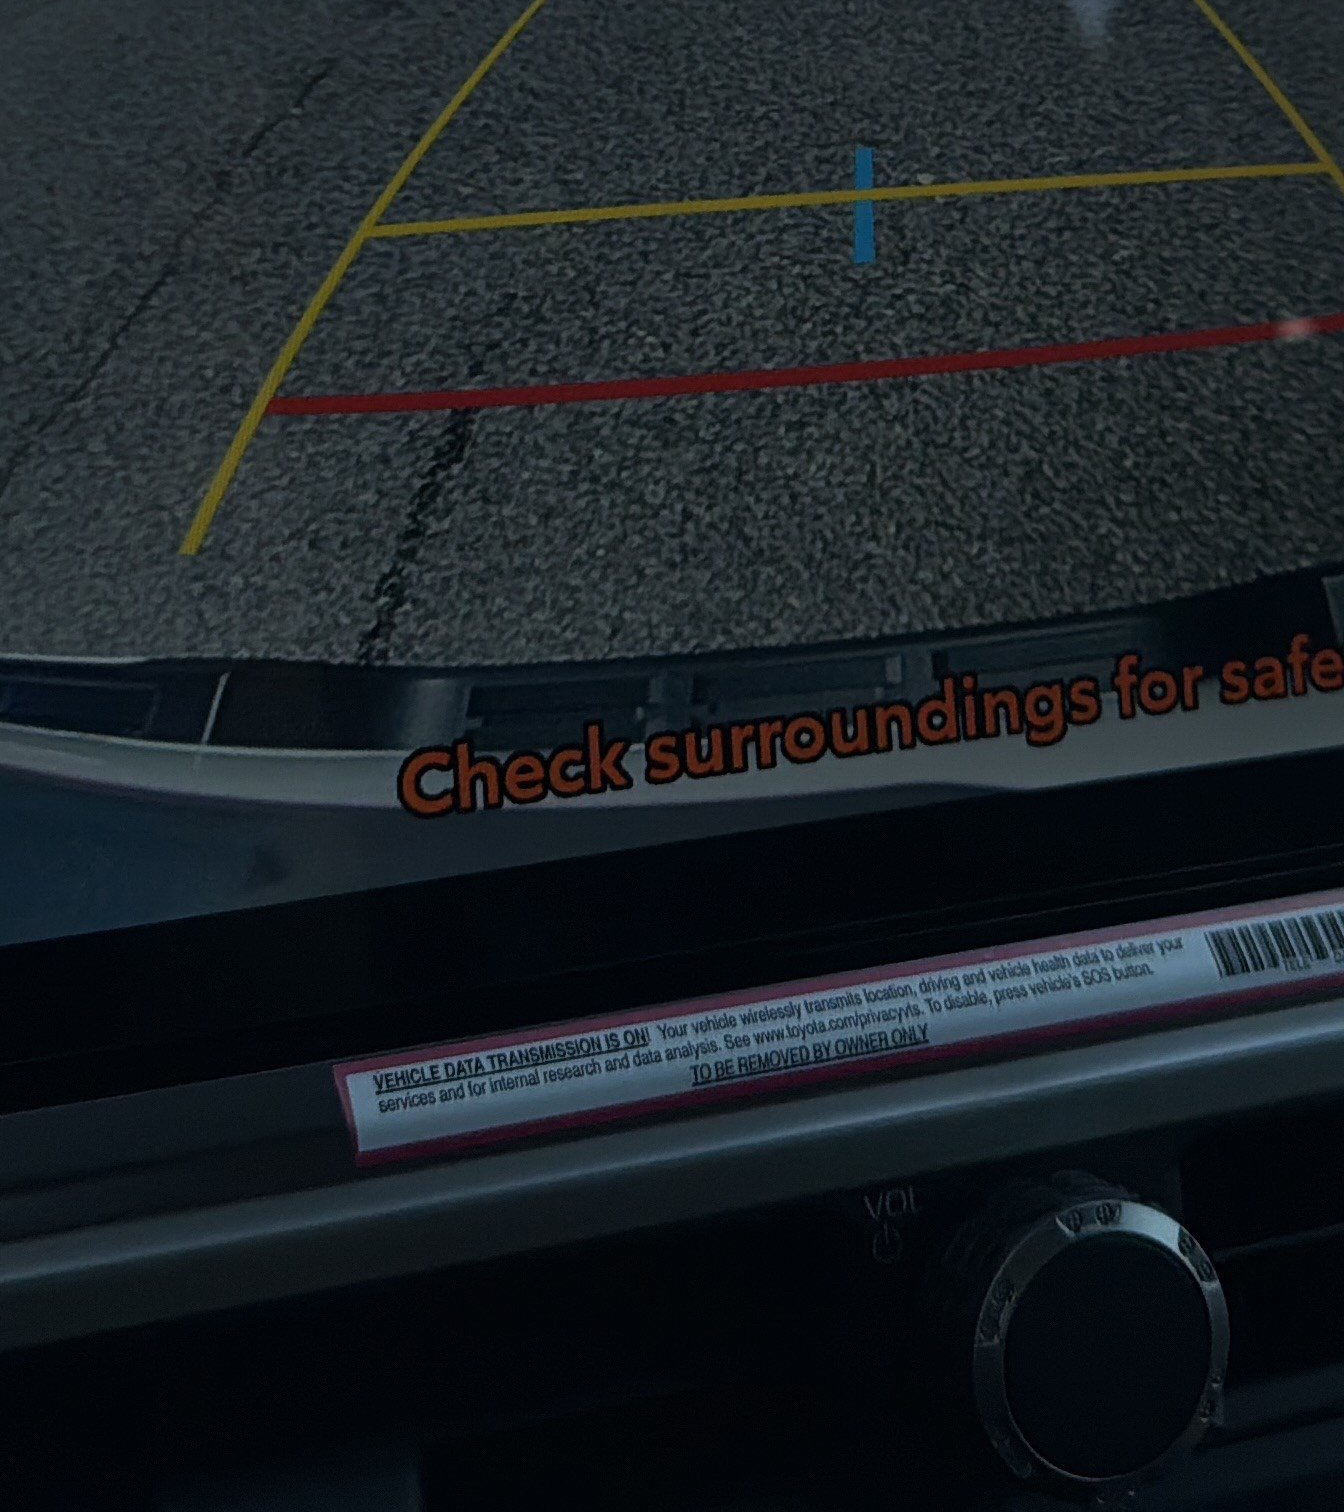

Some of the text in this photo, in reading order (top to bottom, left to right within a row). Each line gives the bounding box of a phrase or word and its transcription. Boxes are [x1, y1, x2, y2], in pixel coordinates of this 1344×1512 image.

[398, 720, 632, 818] Check
[644, 670, 1102, 785] surroundings
[1113, 650, 1208, 719] for
[372, 935, 1184, 1091] VEHICLE DATA TRANSMISSION IS ON! Your vehicle wirelessly transmits location, driving and vehicle health data to deliver your
[377, 1088, 436, 1113] services
[438, 1083, 465, 1102] and
[467, 1079, 486, 1097] for
[488, 1068, 541, 1093] internal
[542, 1057, 602, 1083] research
[604, 1052, 630, 1072] and
[631, 1046, 662, 1067] data
[664, 1036, 722, 1064] analysis.
[723, 1031, 751, 1050] See
[925, 996, 941, 1013] To
[942, 987, 992, 1012] disable,
[992, 982, 1028, 1005] press
[1029, 971, 1081, 995] vehicle's
[1081, 966, 1111, 986] SOS
[1112, 959, 1154, 981] button.
[689, 1022, 929, 1082] TO BE REMOVED BY OWNER ONLY
